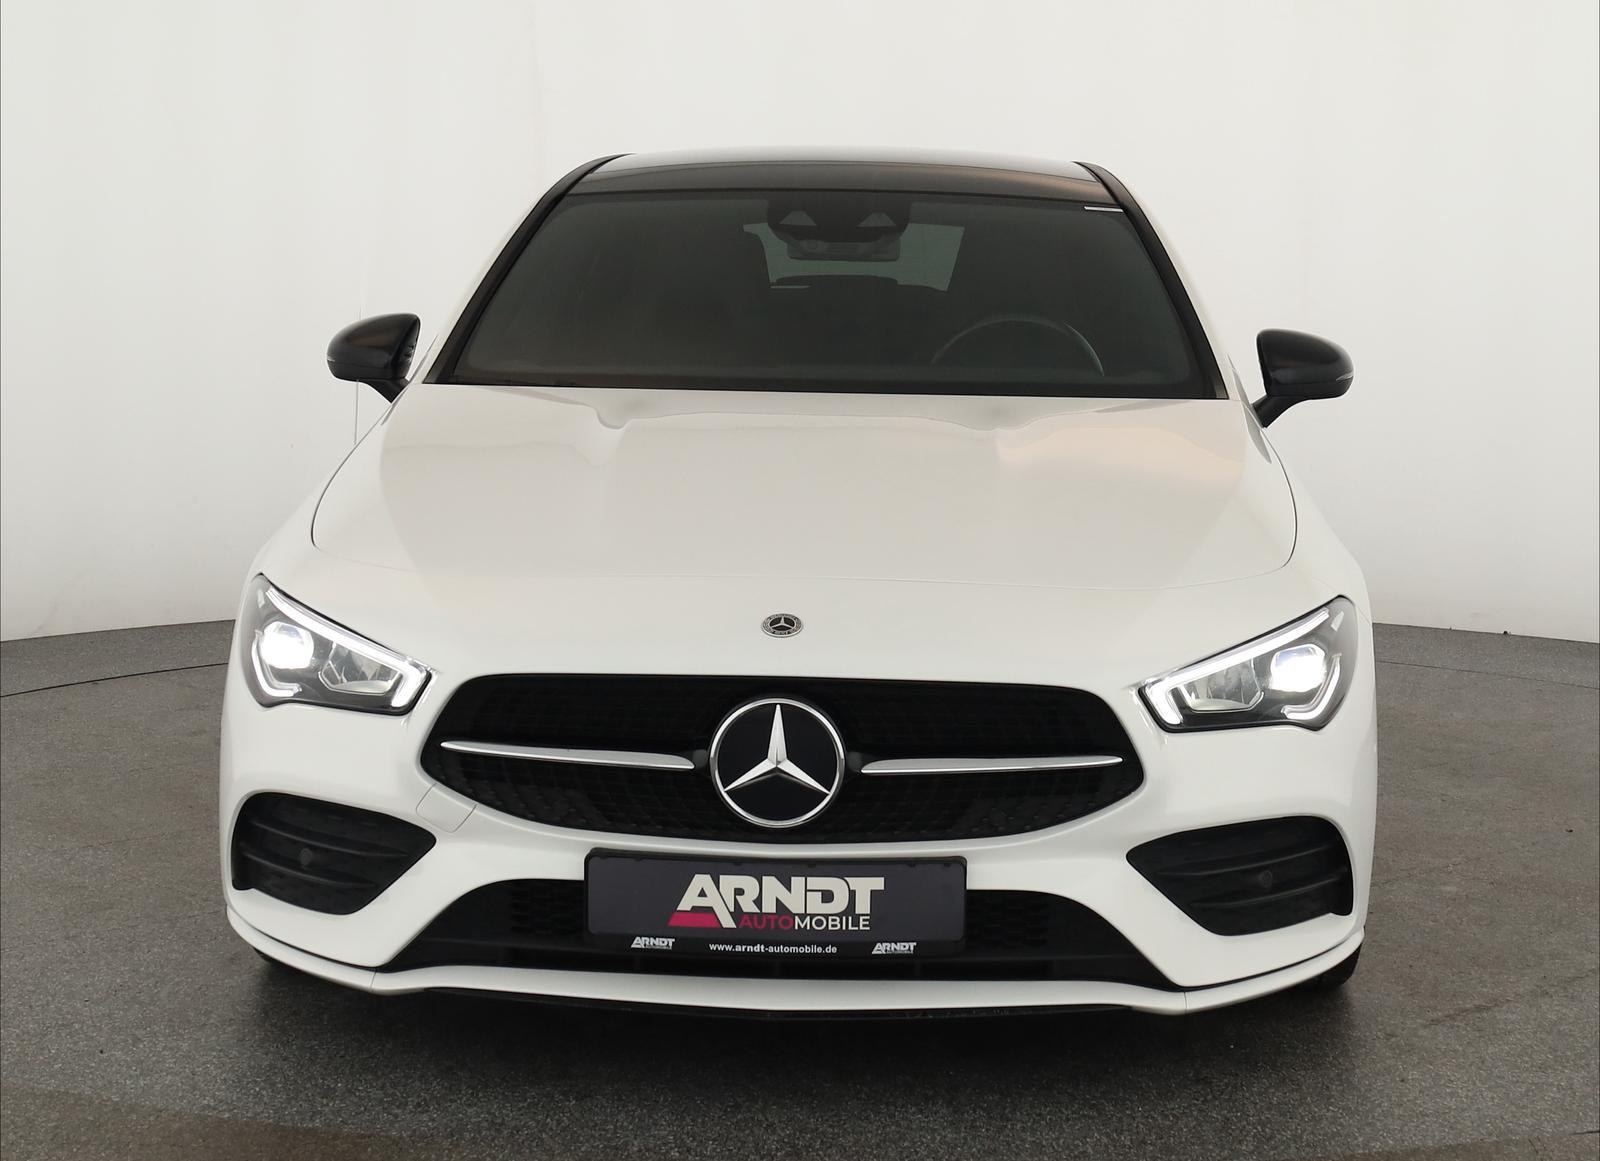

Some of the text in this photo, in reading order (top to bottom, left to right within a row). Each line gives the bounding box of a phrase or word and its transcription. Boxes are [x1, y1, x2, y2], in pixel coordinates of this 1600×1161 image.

[674, 873, 885, 928] ARNDT
[739, 914, 871, 931] AUTOMOBILE
[631, 936, 675, 949] ARNDT
[708, 943, 838, 955] www.arndt-automobile.de
[872, 942, 917, 954] ARNDT
